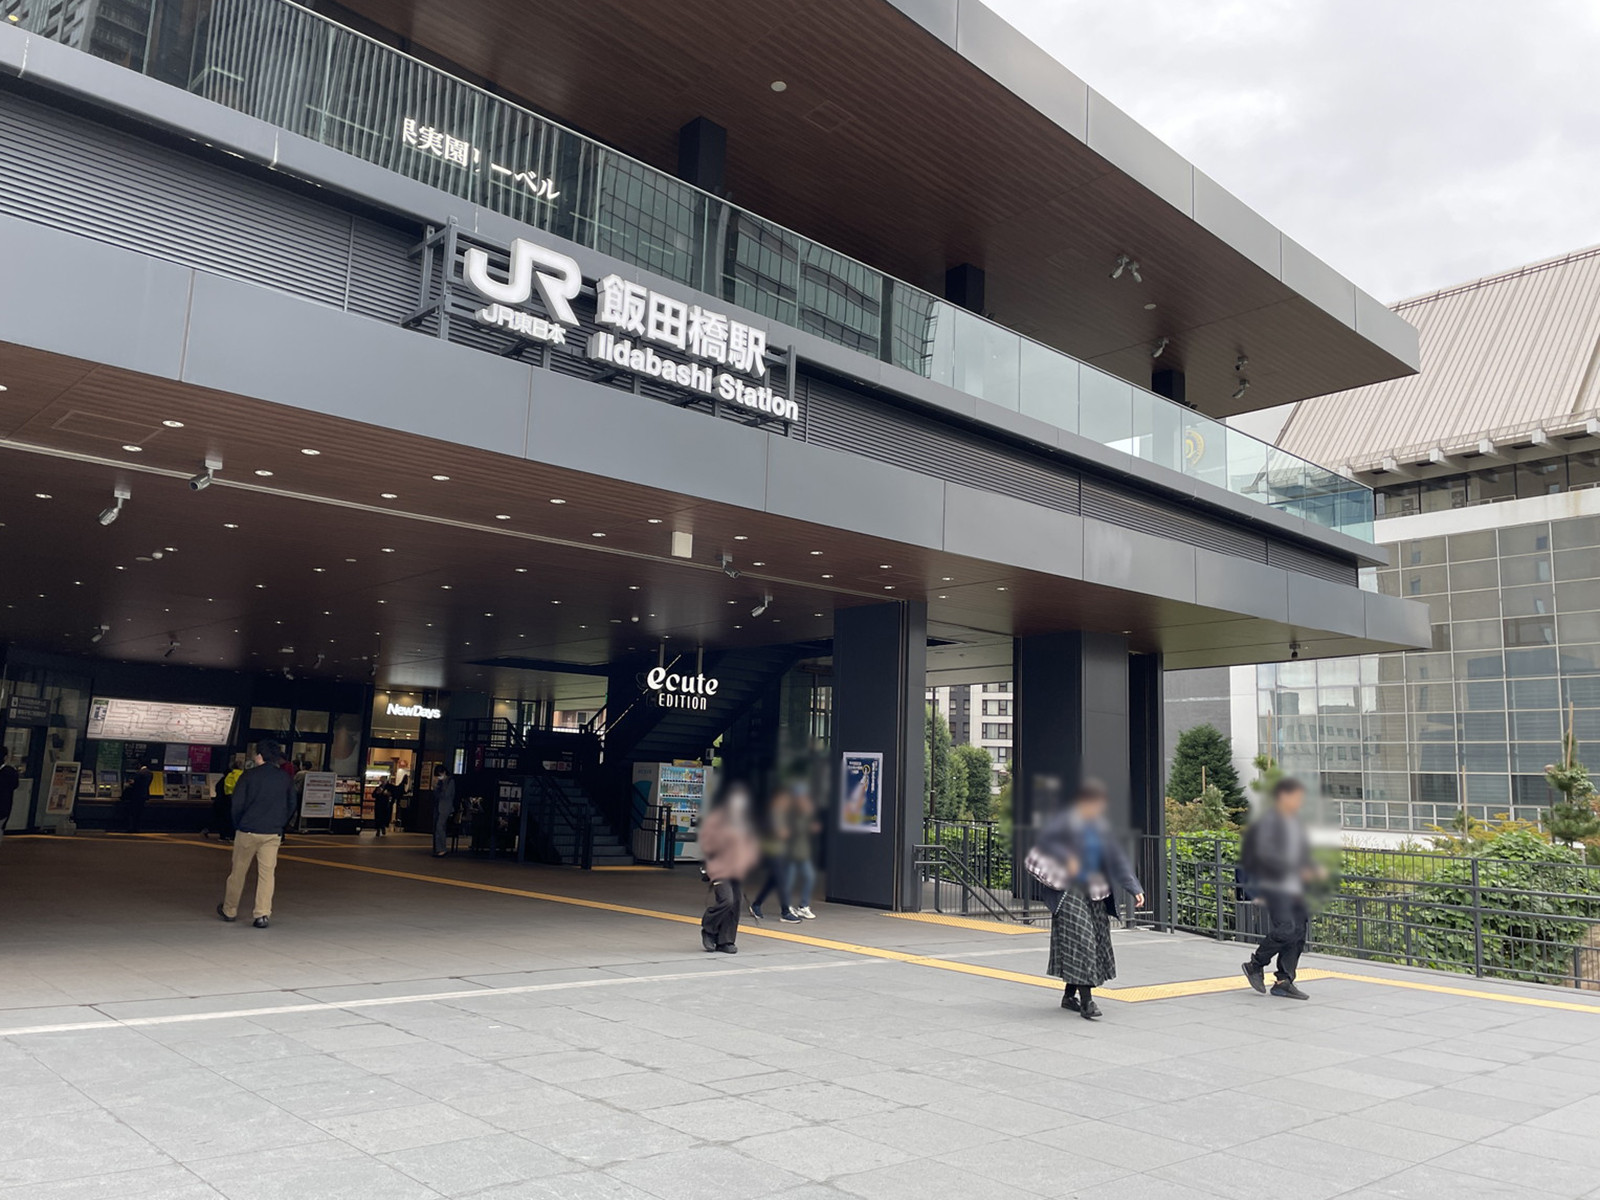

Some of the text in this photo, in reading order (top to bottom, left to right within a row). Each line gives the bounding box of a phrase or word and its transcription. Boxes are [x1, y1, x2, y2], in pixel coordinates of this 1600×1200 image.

[463, 238, 582, 327] JR
[477, 302, 567, 345] JR東日本
[599, 273, 767, 377] 飯田橋駅
[593, 330, 799, 421] Iidabashi Station
[646, 666, 719, 696] ecute
[658, 692, 707, 711] EDITION
[386, 702, 442, 720] NewDays
